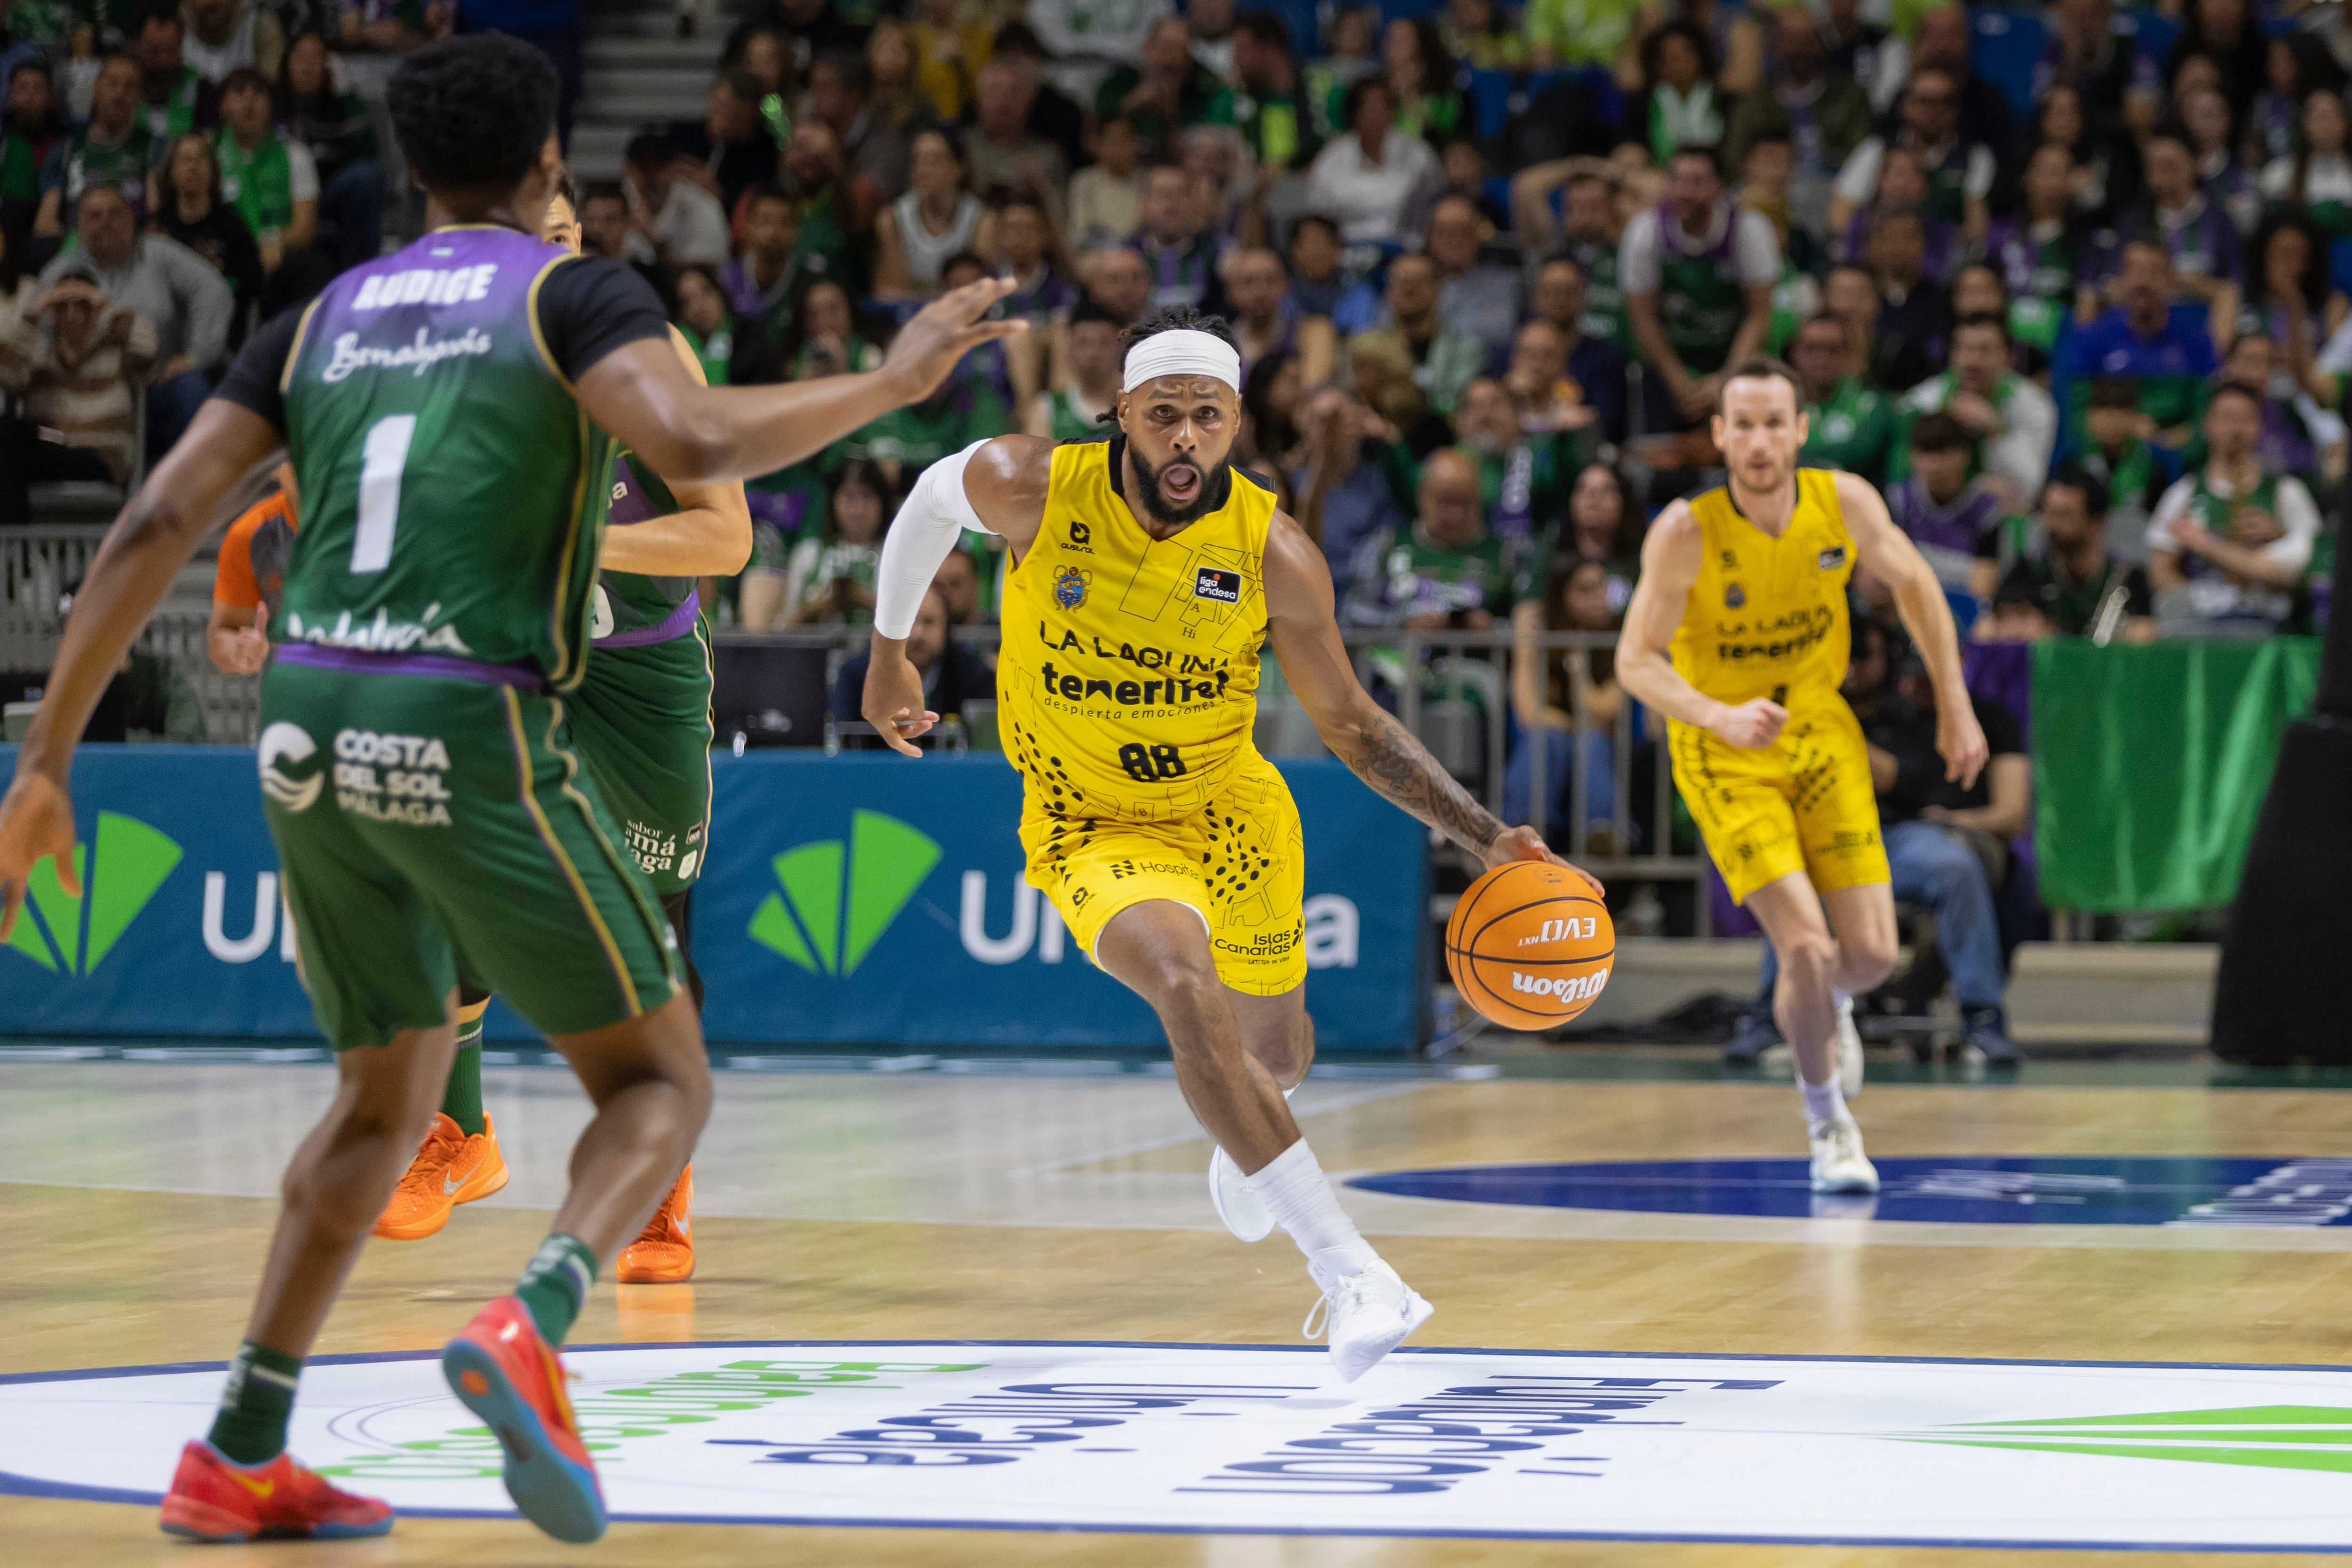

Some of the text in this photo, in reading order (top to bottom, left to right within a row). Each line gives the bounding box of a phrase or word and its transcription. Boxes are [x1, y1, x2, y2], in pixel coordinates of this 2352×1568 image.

[350, 415, 417, 573] 1
[1199, 587, 1236, 599] endesa
[1200, 576, 1218, 587] liga
[1190, 603, 1200, 613] A
[1040, 620, 1086, 654] LA
[1182, 627, 1197, 639] Hi
[1044, 696, 1215, 719] despierta emociones
[333, 728, 452, 770] COSTA
[1118, 742, 1187, 782] 88
[386, 770, 452, 799] SOL
[1215, 939, 1290, 955] Canarias
[1254, 930, 1290, 945] Islas
[1512, 968, 1608, 1003] Wilson
[707, 1383, 1320, 1466] Unicaja
[1172, 1376, 1788, 1494] Fundación
